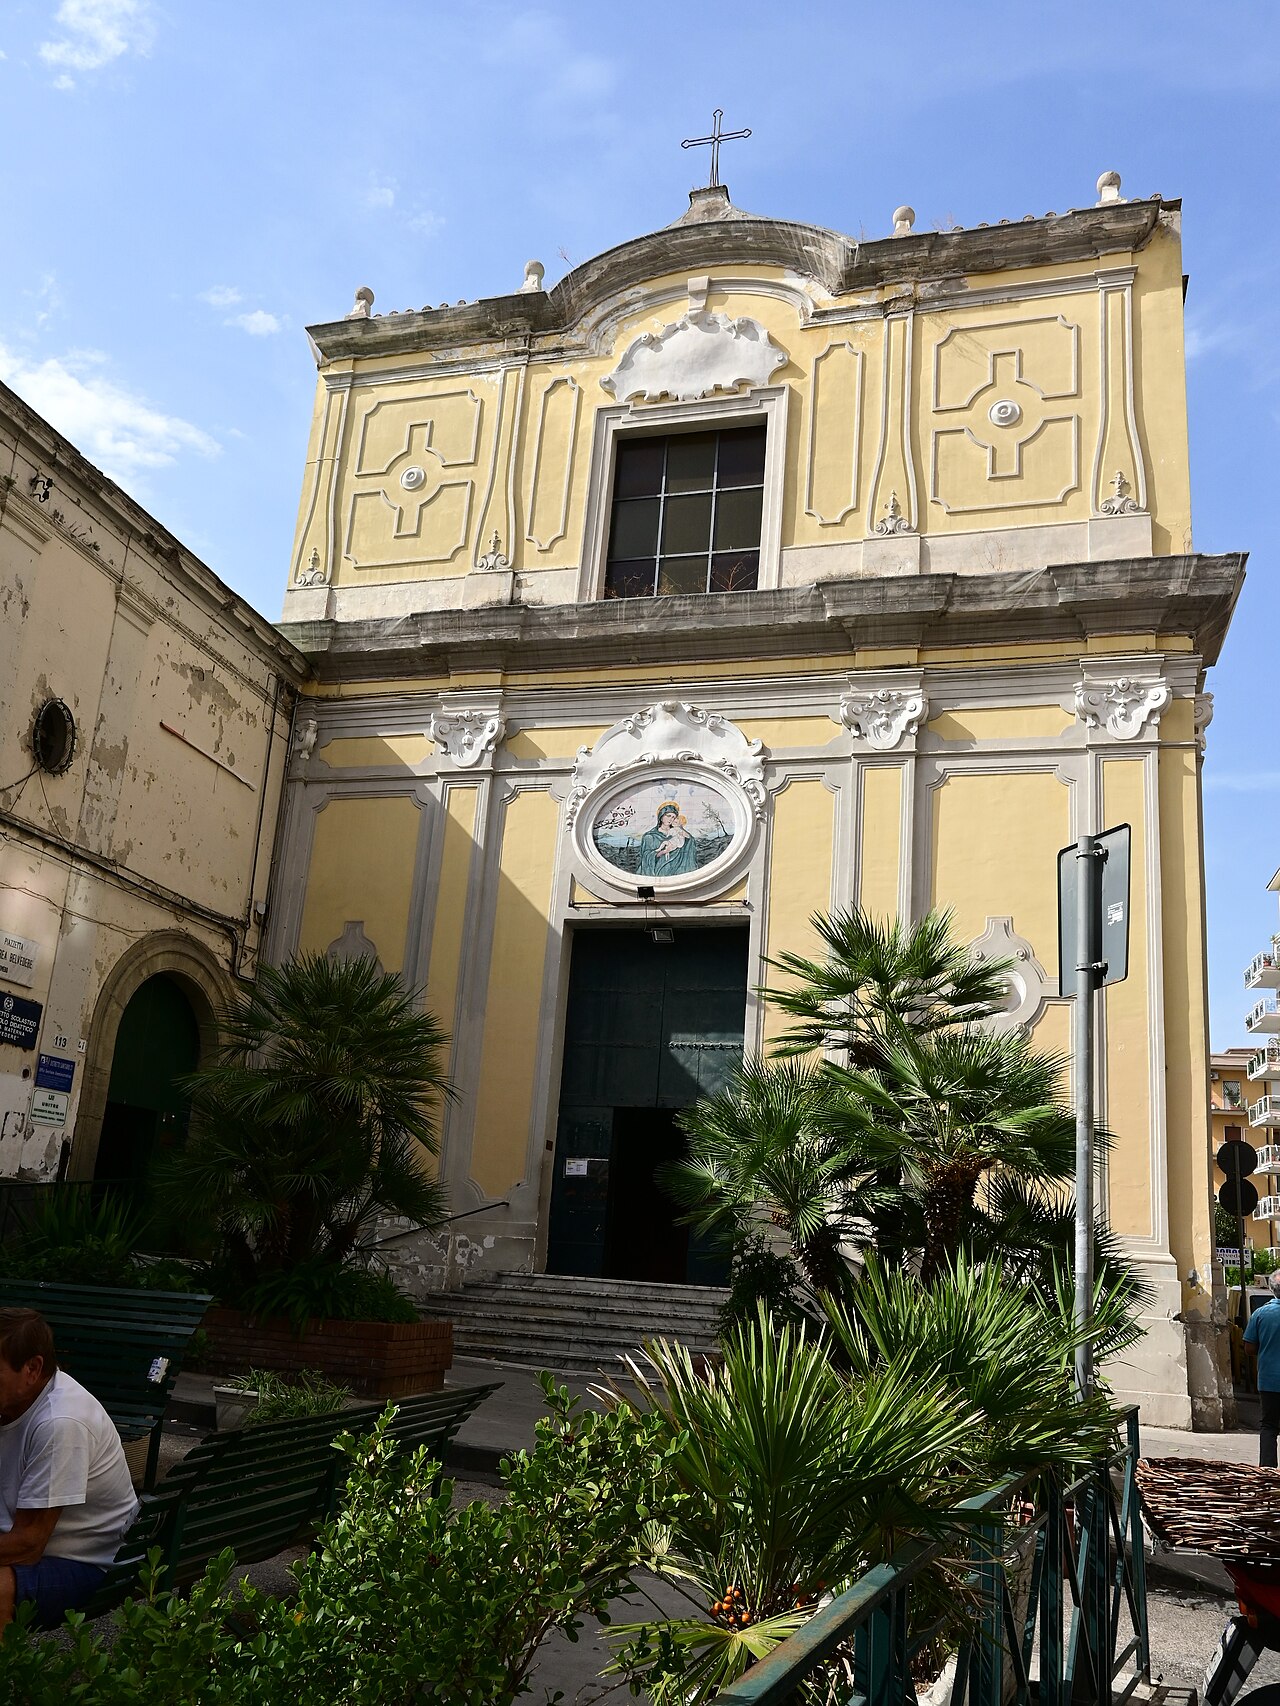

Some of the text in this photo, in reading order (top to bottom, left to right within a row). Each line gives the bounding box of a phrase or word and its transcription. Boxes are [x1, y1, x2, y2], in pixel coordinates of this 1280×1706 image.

[9, 952, 33, 969] BELVEDERE
[9, 1021, 34, 1033] DIDATTICO
[10, 1014, 37, 1027] SCOLASTICO
[54, 1035, 67, 1048] 113
